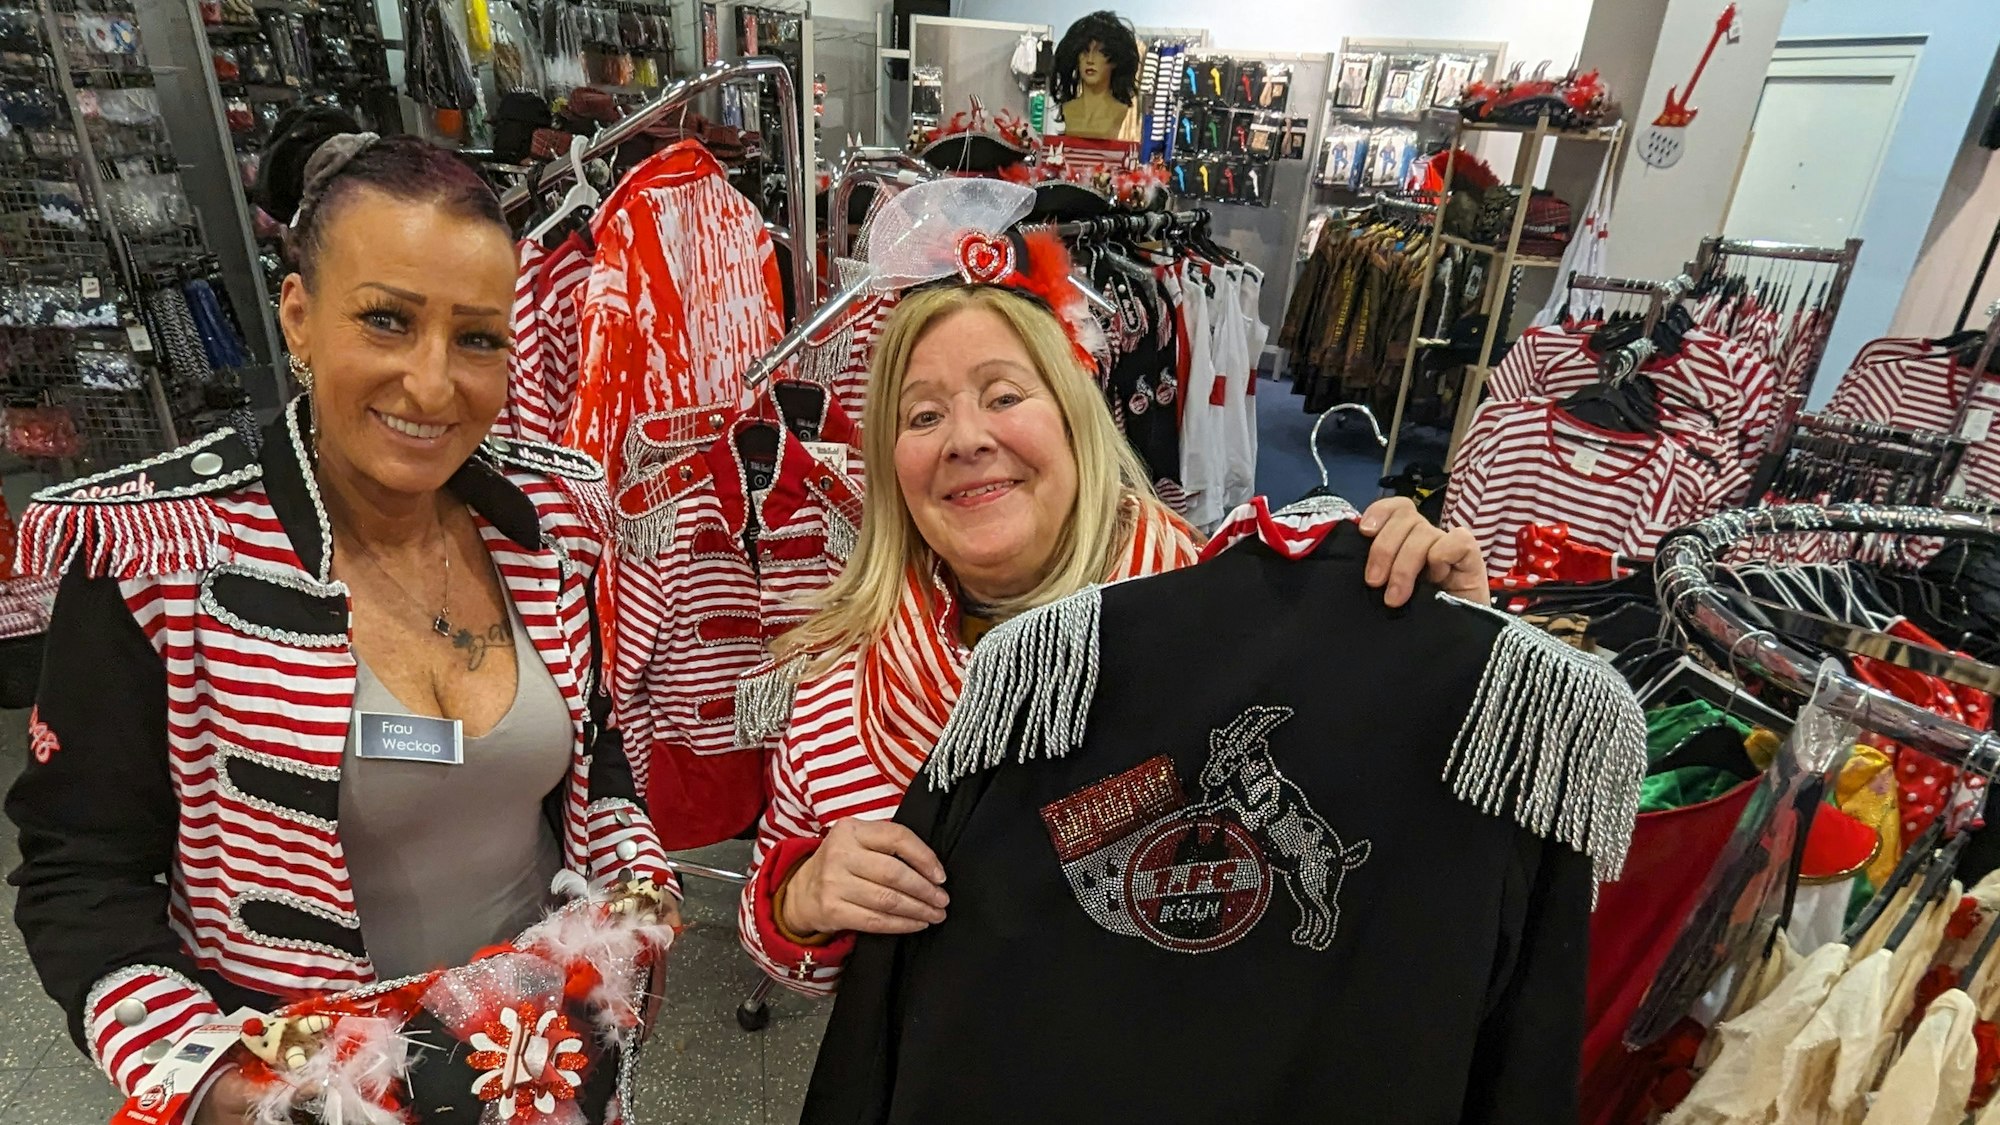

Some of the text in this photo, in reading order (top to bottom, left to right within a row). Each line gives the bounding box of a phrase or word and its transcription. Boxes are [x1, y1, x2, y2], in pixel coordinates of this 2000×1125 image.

[382, 721, 413, 735] Frau
[382, 738, 441, 755] Weckop
[1160, 899, 1220, 922] KÖLN
